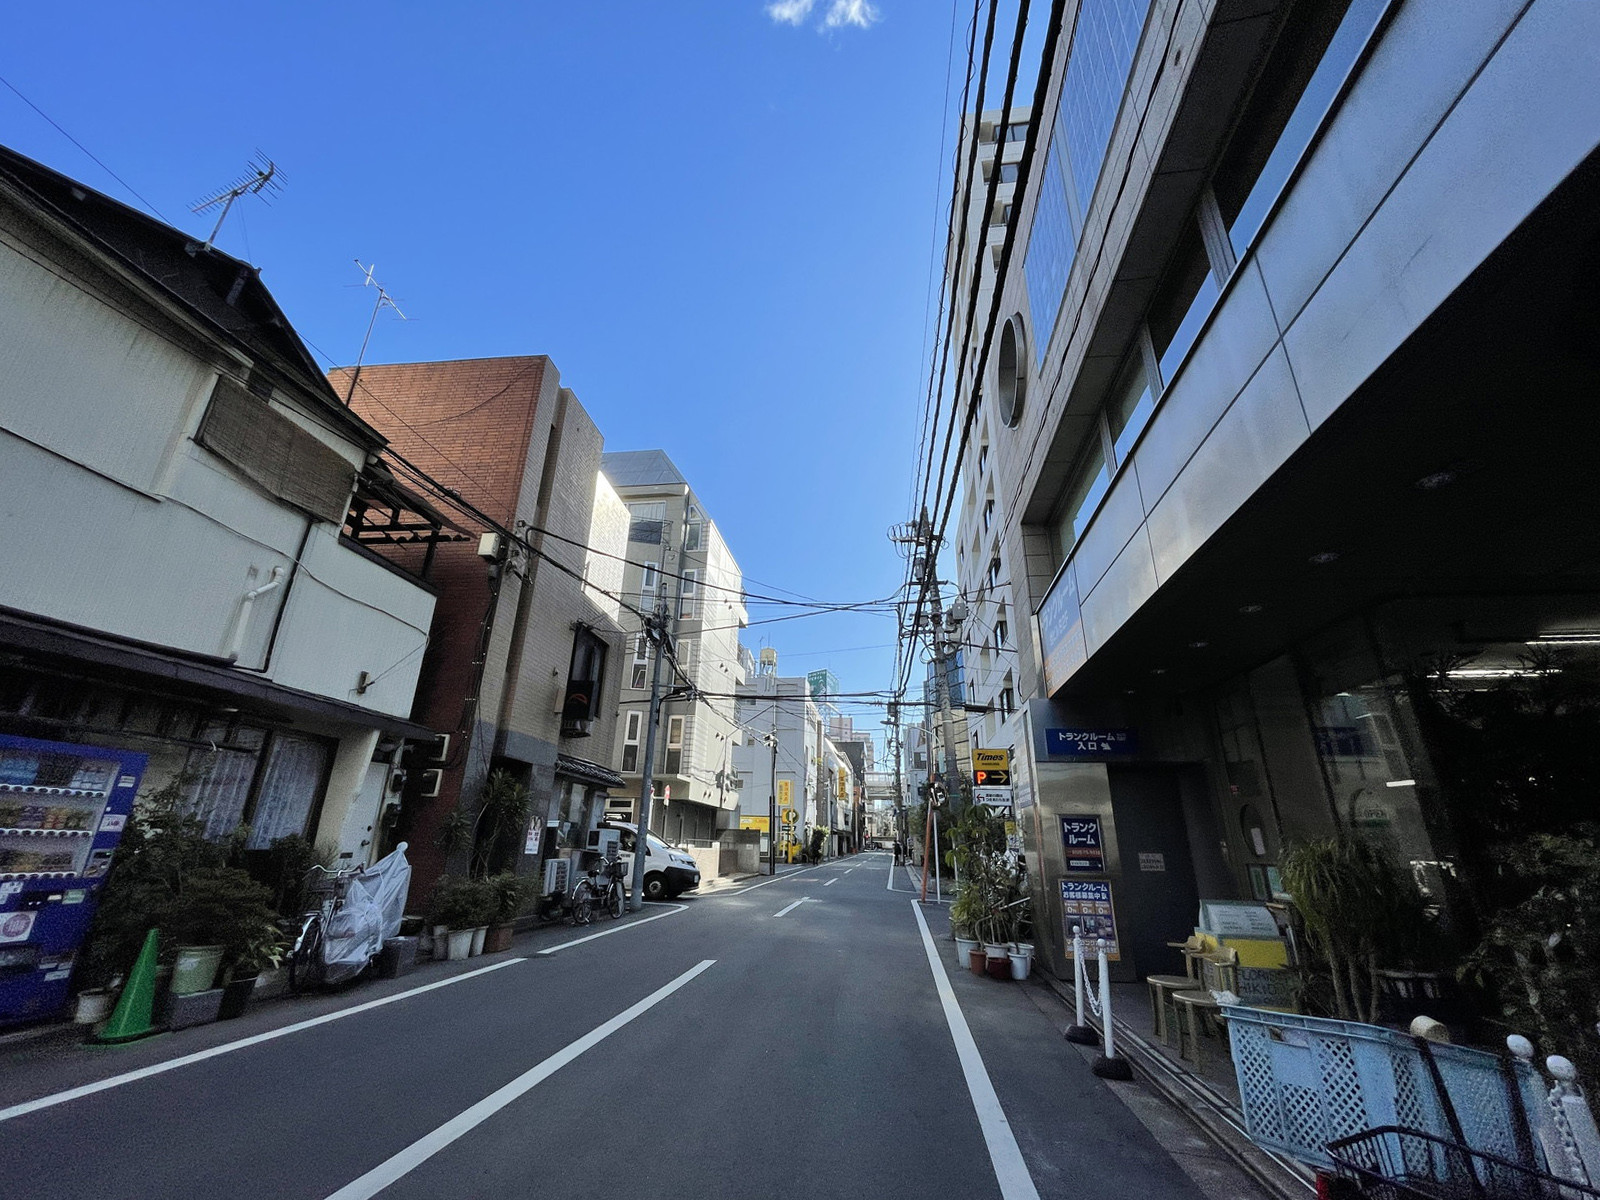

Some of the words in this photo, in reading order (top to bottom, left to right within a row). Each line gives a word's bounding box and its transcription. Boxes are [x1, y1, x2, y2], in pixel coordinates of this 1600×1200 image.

[1059, 732, 1116, 741] トランクルーム
[1078, 742, 1098, 750] 入口
[977, 771, 987, 784] P
[1063, 822, 1097, 832] トランク
[1069, 834, 1095, 845] ルーム
[1061, 882, 1108, 892] トランクルーム
